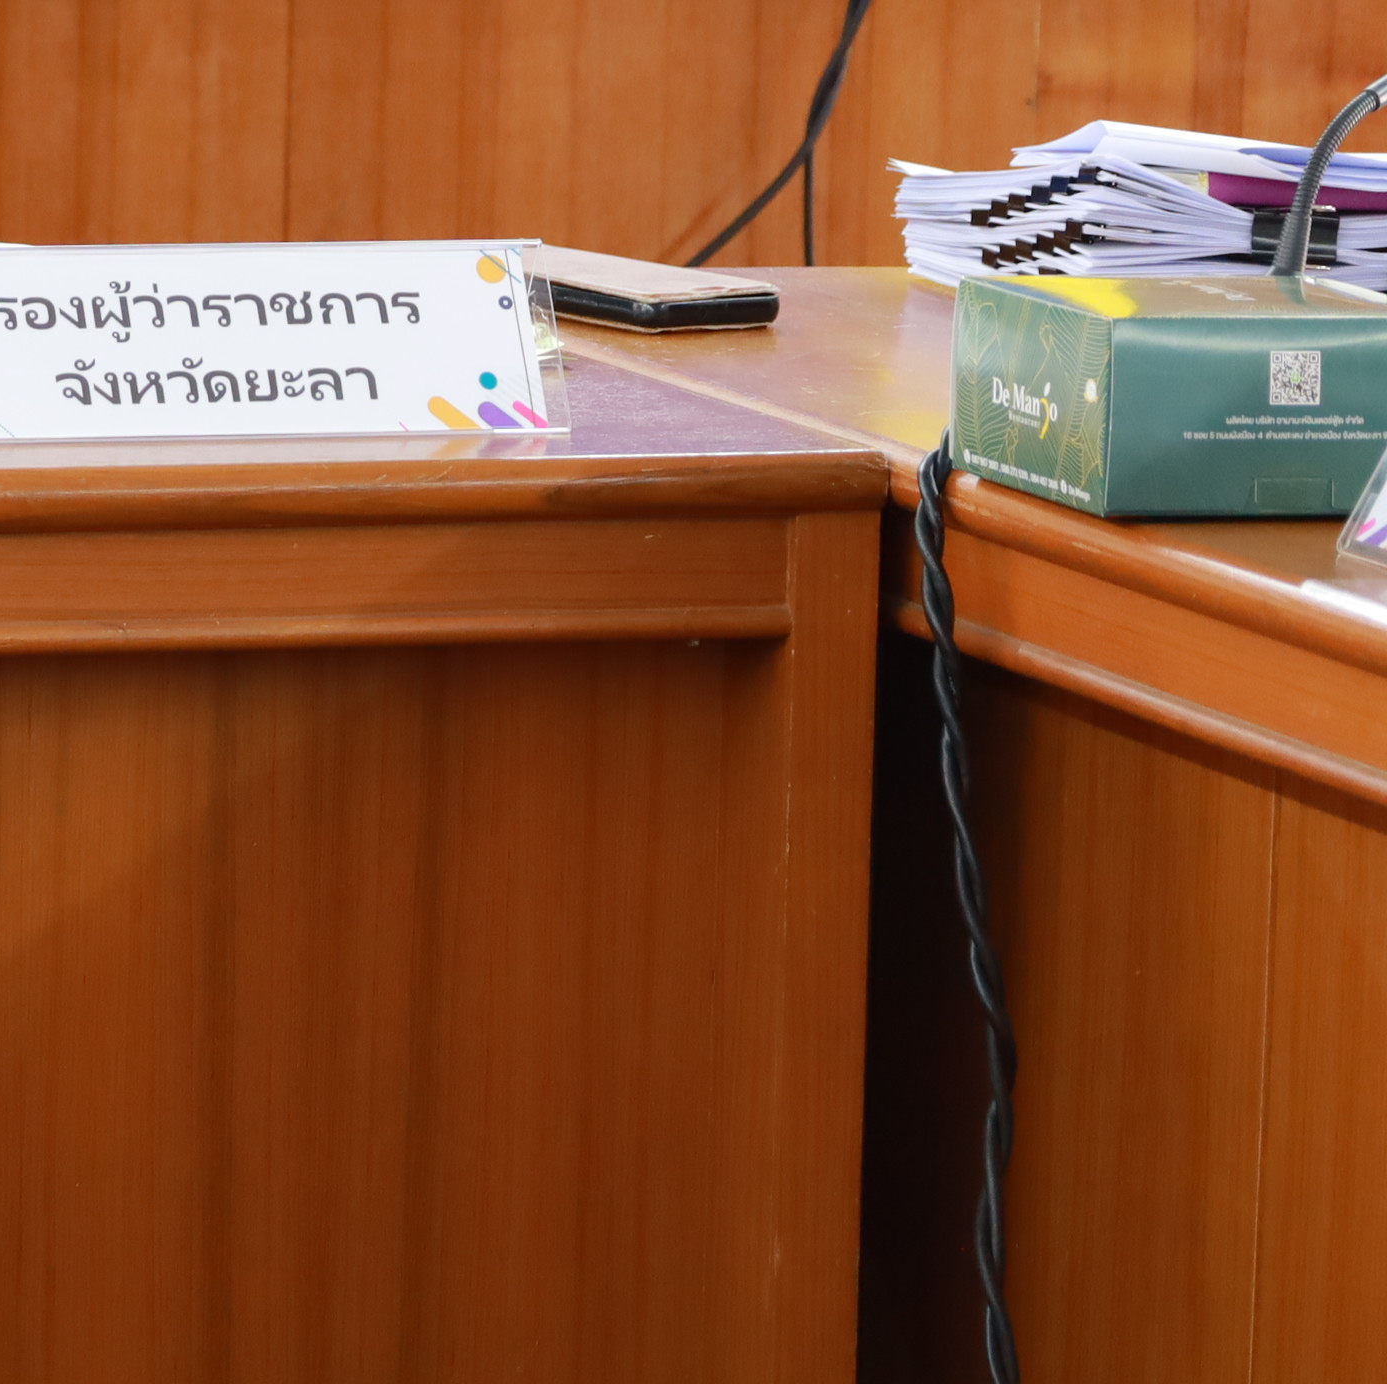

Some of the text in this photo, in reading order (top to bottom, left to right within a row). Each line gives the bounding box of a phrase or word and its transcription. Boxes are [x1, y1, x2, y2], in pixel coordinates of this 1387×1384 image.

[55, 356, 379, 406] จังหวัดยะลา
[992, 376, 1011, 407] De
